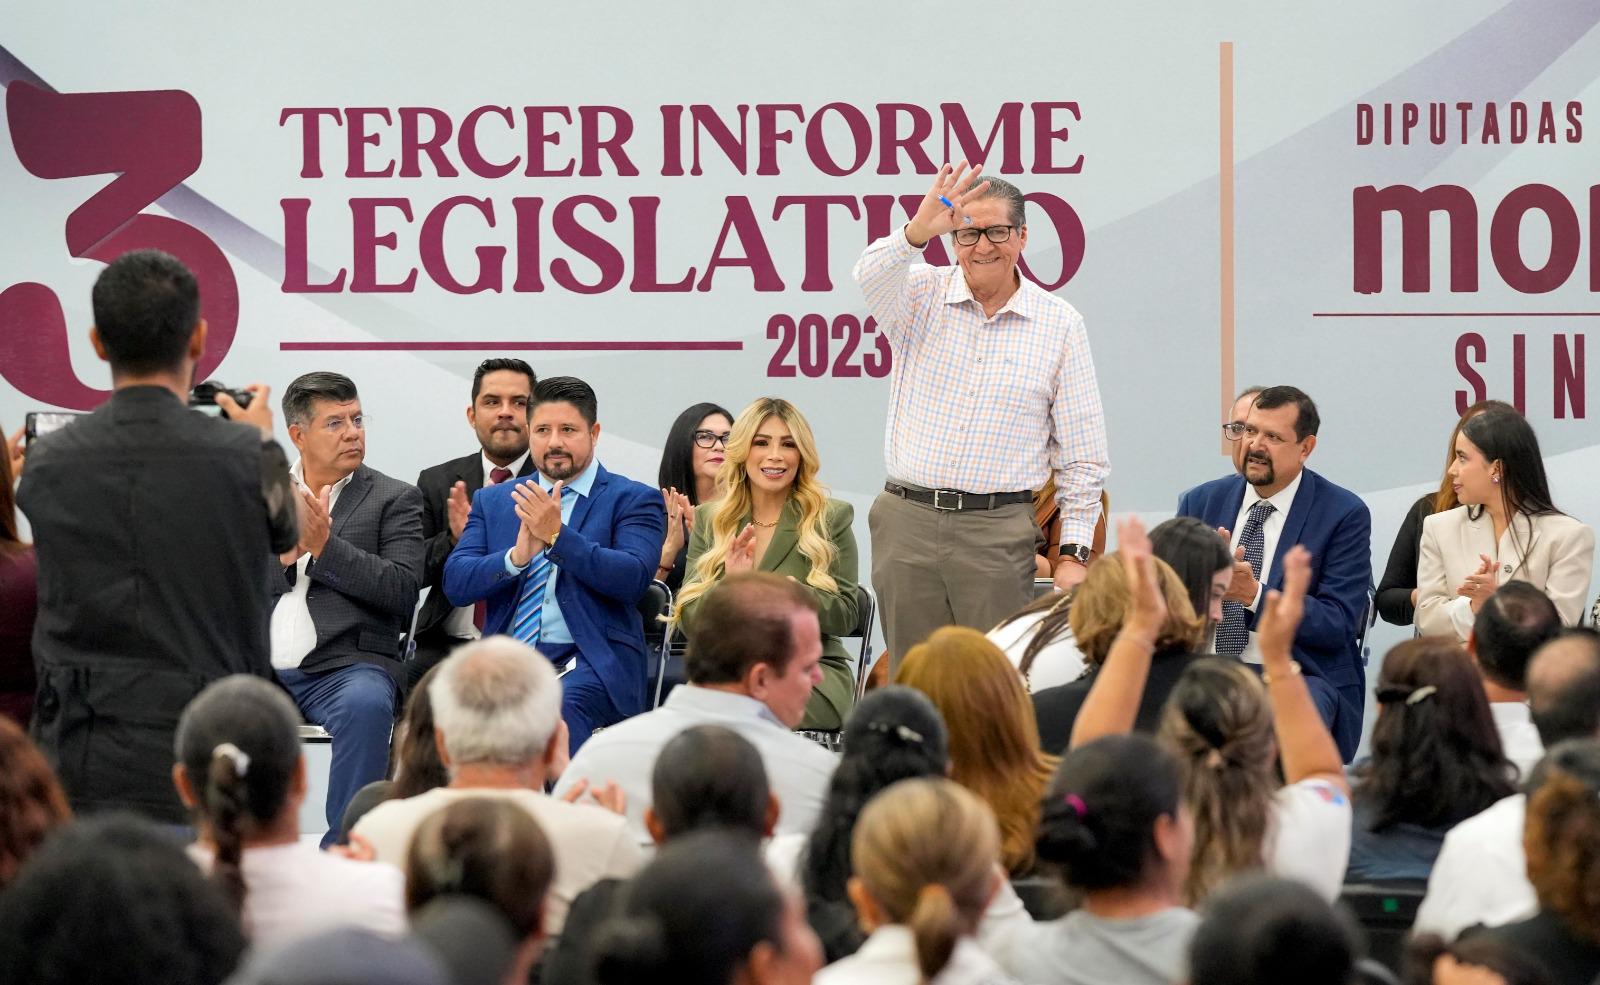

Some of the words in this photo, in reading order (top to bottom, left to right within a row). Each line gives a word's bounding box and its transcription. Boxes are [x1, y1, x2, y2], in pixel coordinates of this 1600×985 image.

[279, 104, 640, 179] TERCER
[660, 101, 1085, 177] INFORME
[1357, 101, 1582, 145] DIPUTADAS
[0, 80, 239, 411] 3
[1353, 183, 1600, 294] mo
[766, 313, 893, 378] 2023
[1455, 332, 1585, 419] SIN
